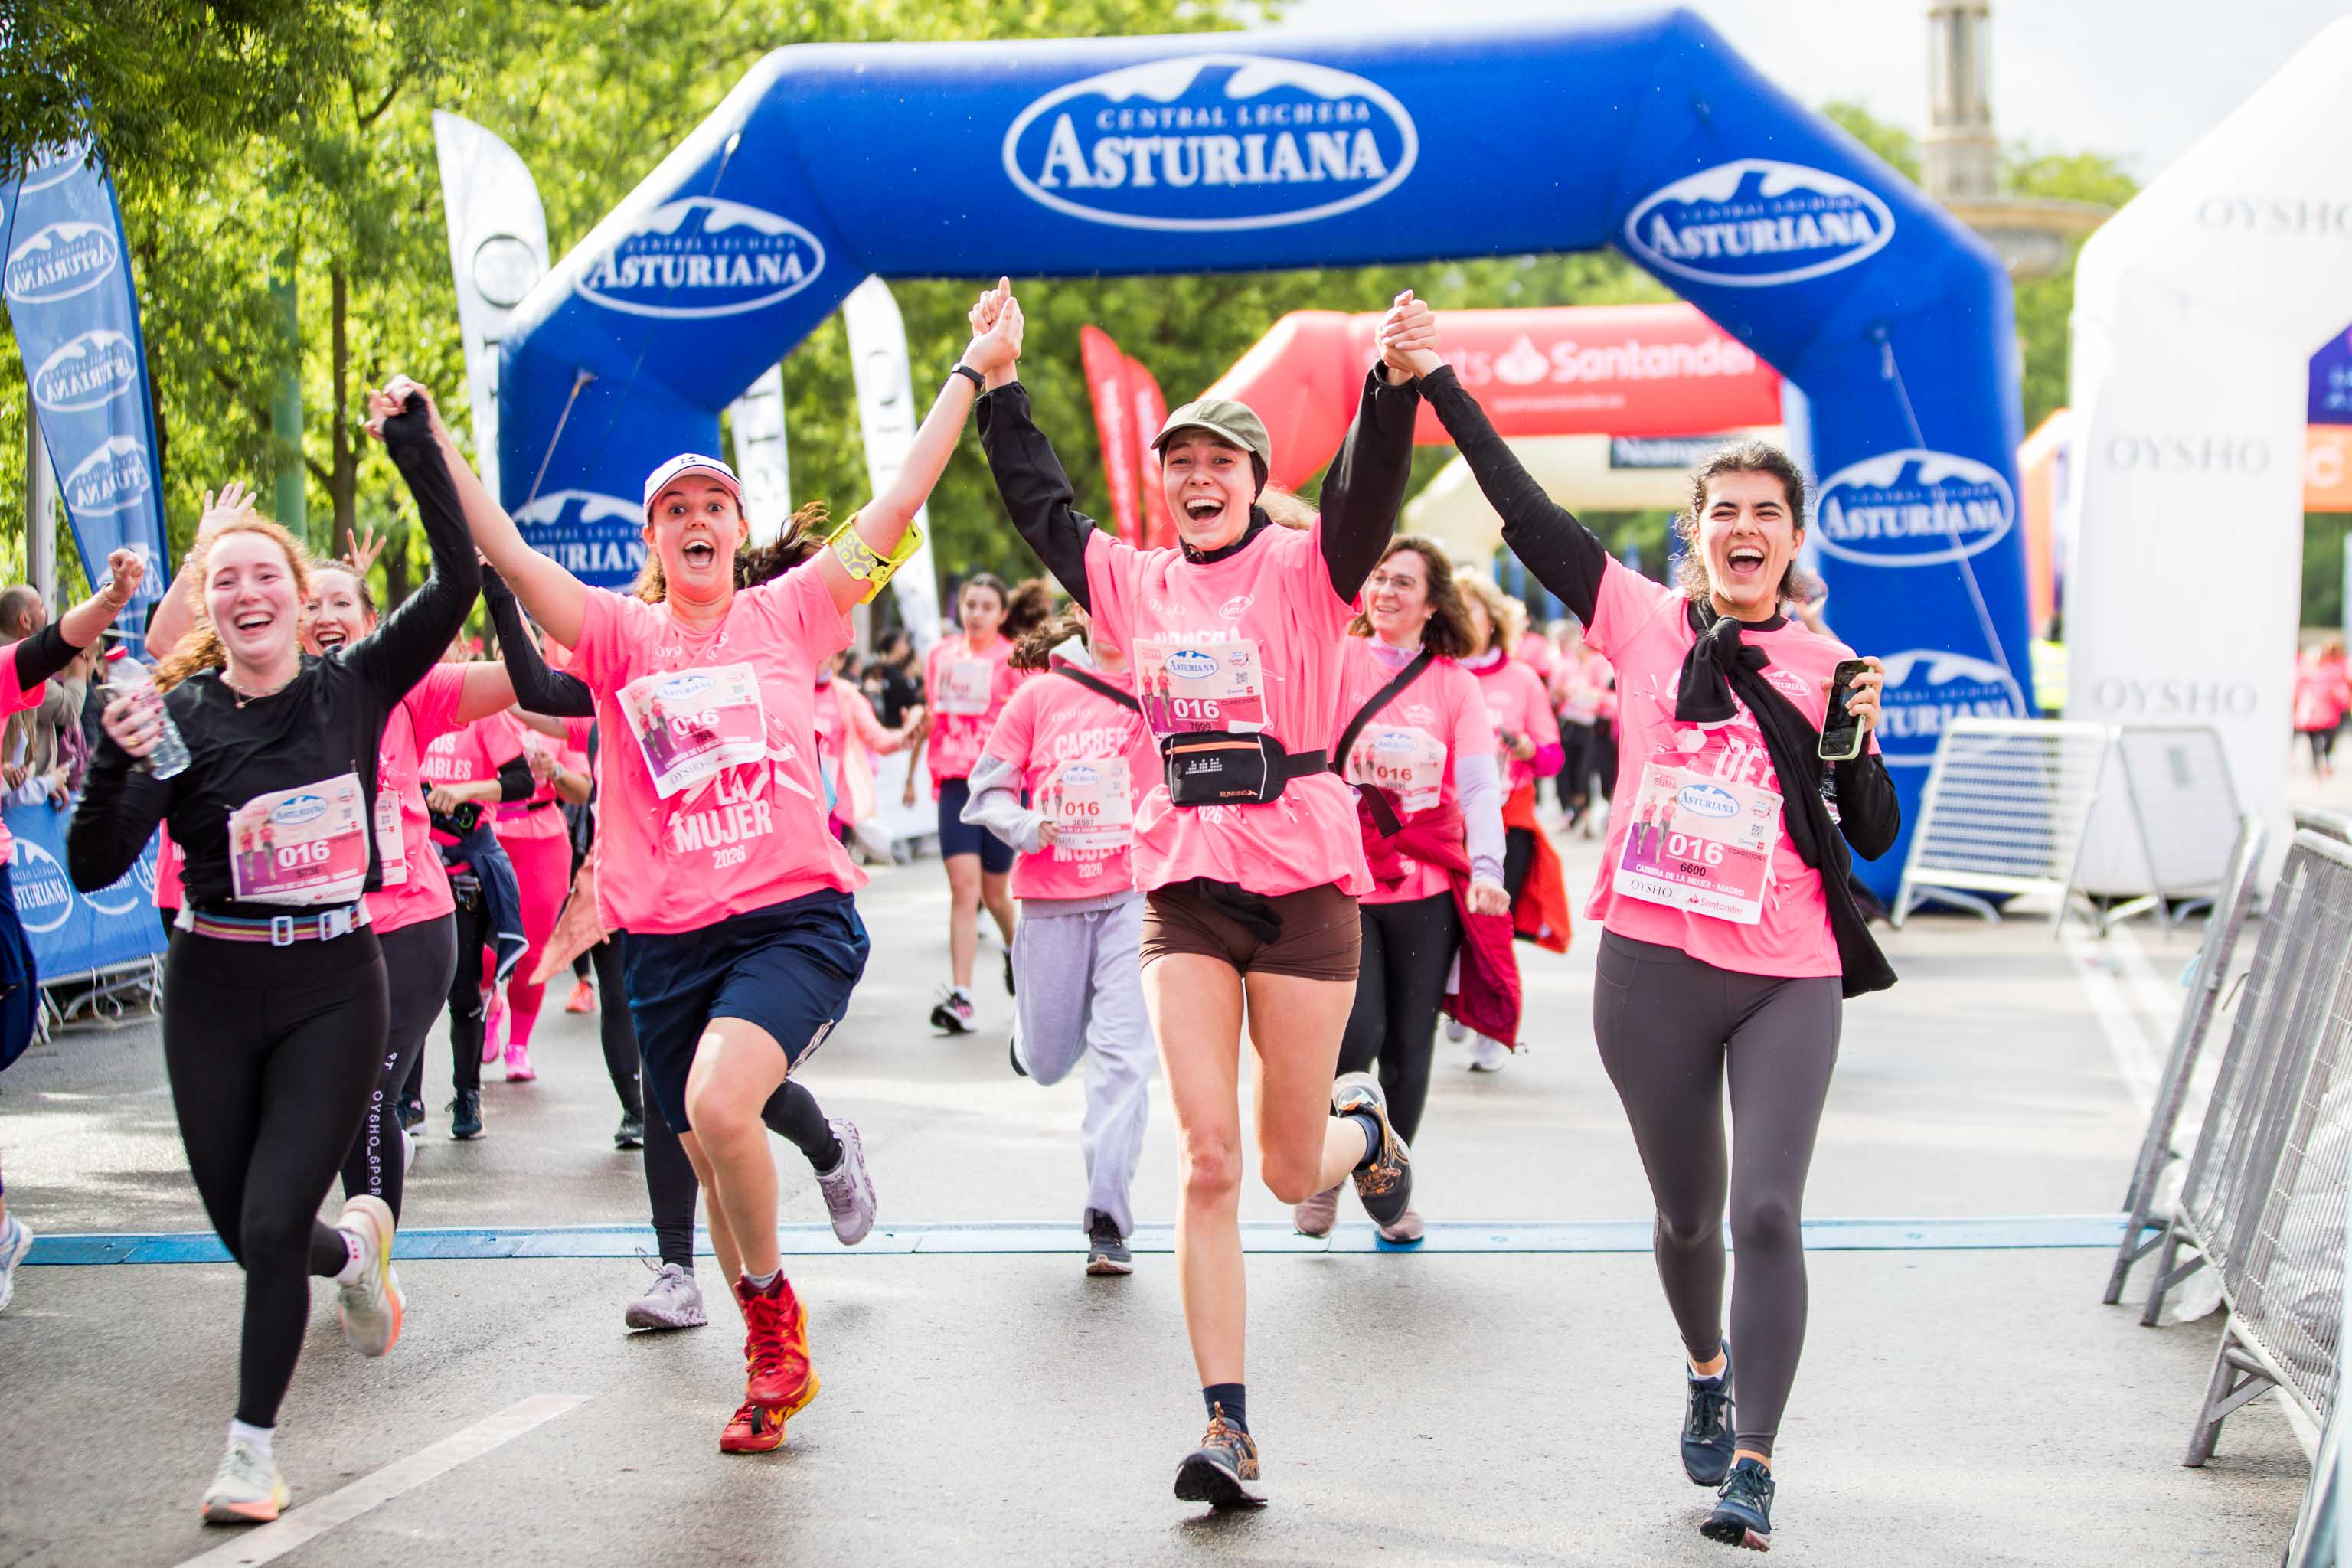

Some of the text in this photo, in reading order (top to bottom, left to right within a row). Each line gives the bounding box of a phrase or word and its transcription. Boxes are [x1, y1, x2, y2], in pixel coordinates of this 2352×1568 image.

[1096, 101, 1371, 131] CENTRAL LECHERA
[2105, 436, 2273, 476] OYSHO
[1170, 661, 1215, 672] ASTURIANA
[1174, 698, 1220, 719] 016
[2092, 677, 2259, 717] OYSHO
[671, 708, 720, 735] 016
[1189, 722, 1212, 732] 7099
[1054, 727, 1128, 760] CARRER
[1377, 766, 1412, 781] 016
[1653, 776, 1677, 790] SUMA
[713, 766, 749, 807] LA
[1065, 802, 1100, 816] 016
[1681, 791, 1735, 815] ASTURIANA
[672, 799, 773, 853] MUJER
[278, 840, 330, 867] 016
[713, 845, 746, 869] 2026
[1668, 834, 1724, 864] 016
[1635, 864, 1745, 897] CARRERA DE LA MUJER MADRID
[1680, 862, 1707, 877] 6600
[1630, 878, 1673, 898] OYSHO
[1700, 897, 1744, 916] Santander
